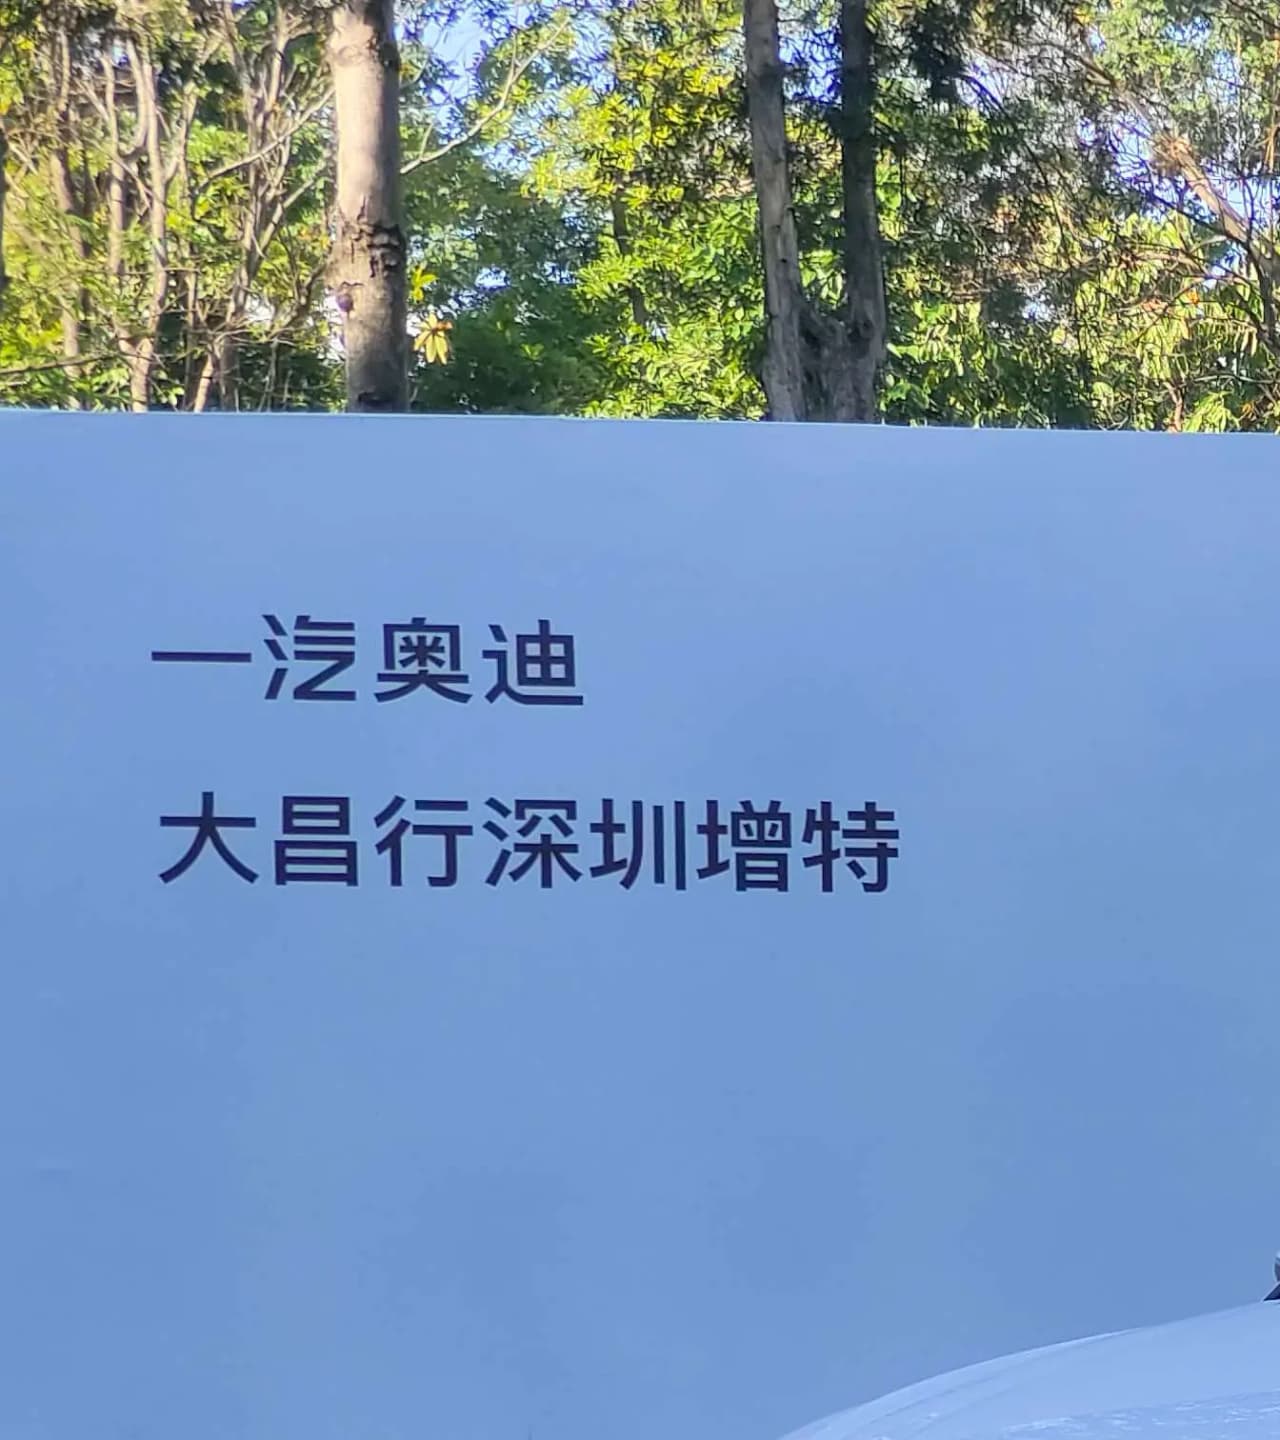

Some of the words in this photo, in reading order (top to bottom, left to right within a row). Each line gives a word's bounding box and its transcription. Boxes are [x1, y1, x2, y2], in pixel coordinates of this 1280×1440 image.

[151, 614, 584, 706] 一汽奥迪
[159, 791, 900, 893] 大昌行深圳增特
